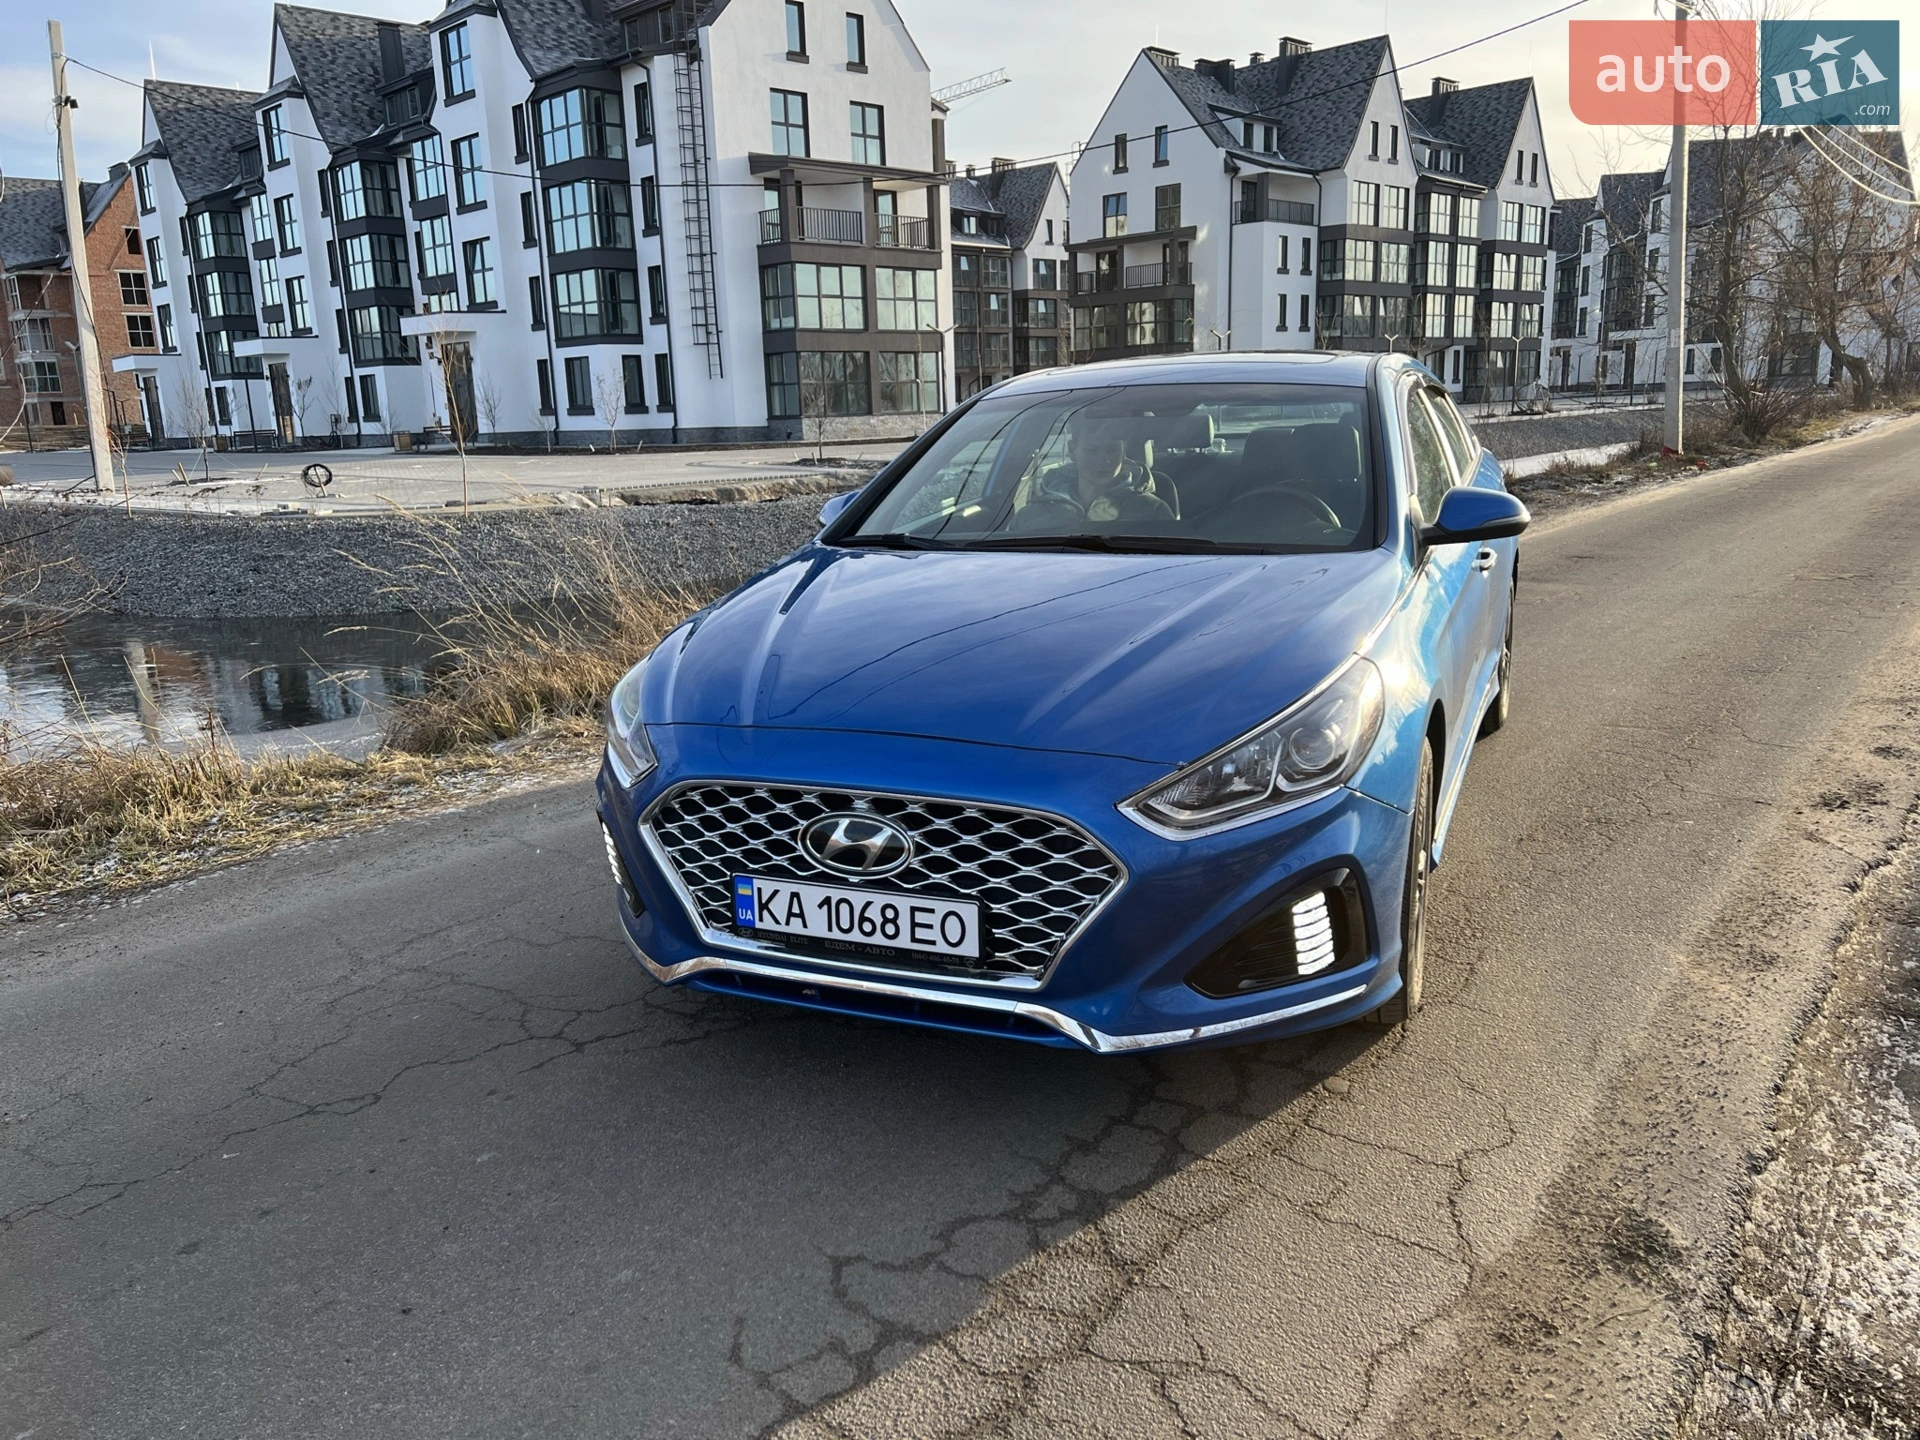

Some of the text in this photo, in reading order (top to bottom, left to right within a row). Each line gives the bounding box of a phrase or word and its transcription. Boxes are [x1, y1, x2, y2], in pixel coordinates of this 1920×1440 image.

[738, 908, 753, 921] UA
[757, 886, 966, 948] KA 1068 EO
[757, 931, 787, 941] HYUNDAI
[824, 940, 856, 952] ЕДЕМ
[864, 946, 896, 957] АВТО
